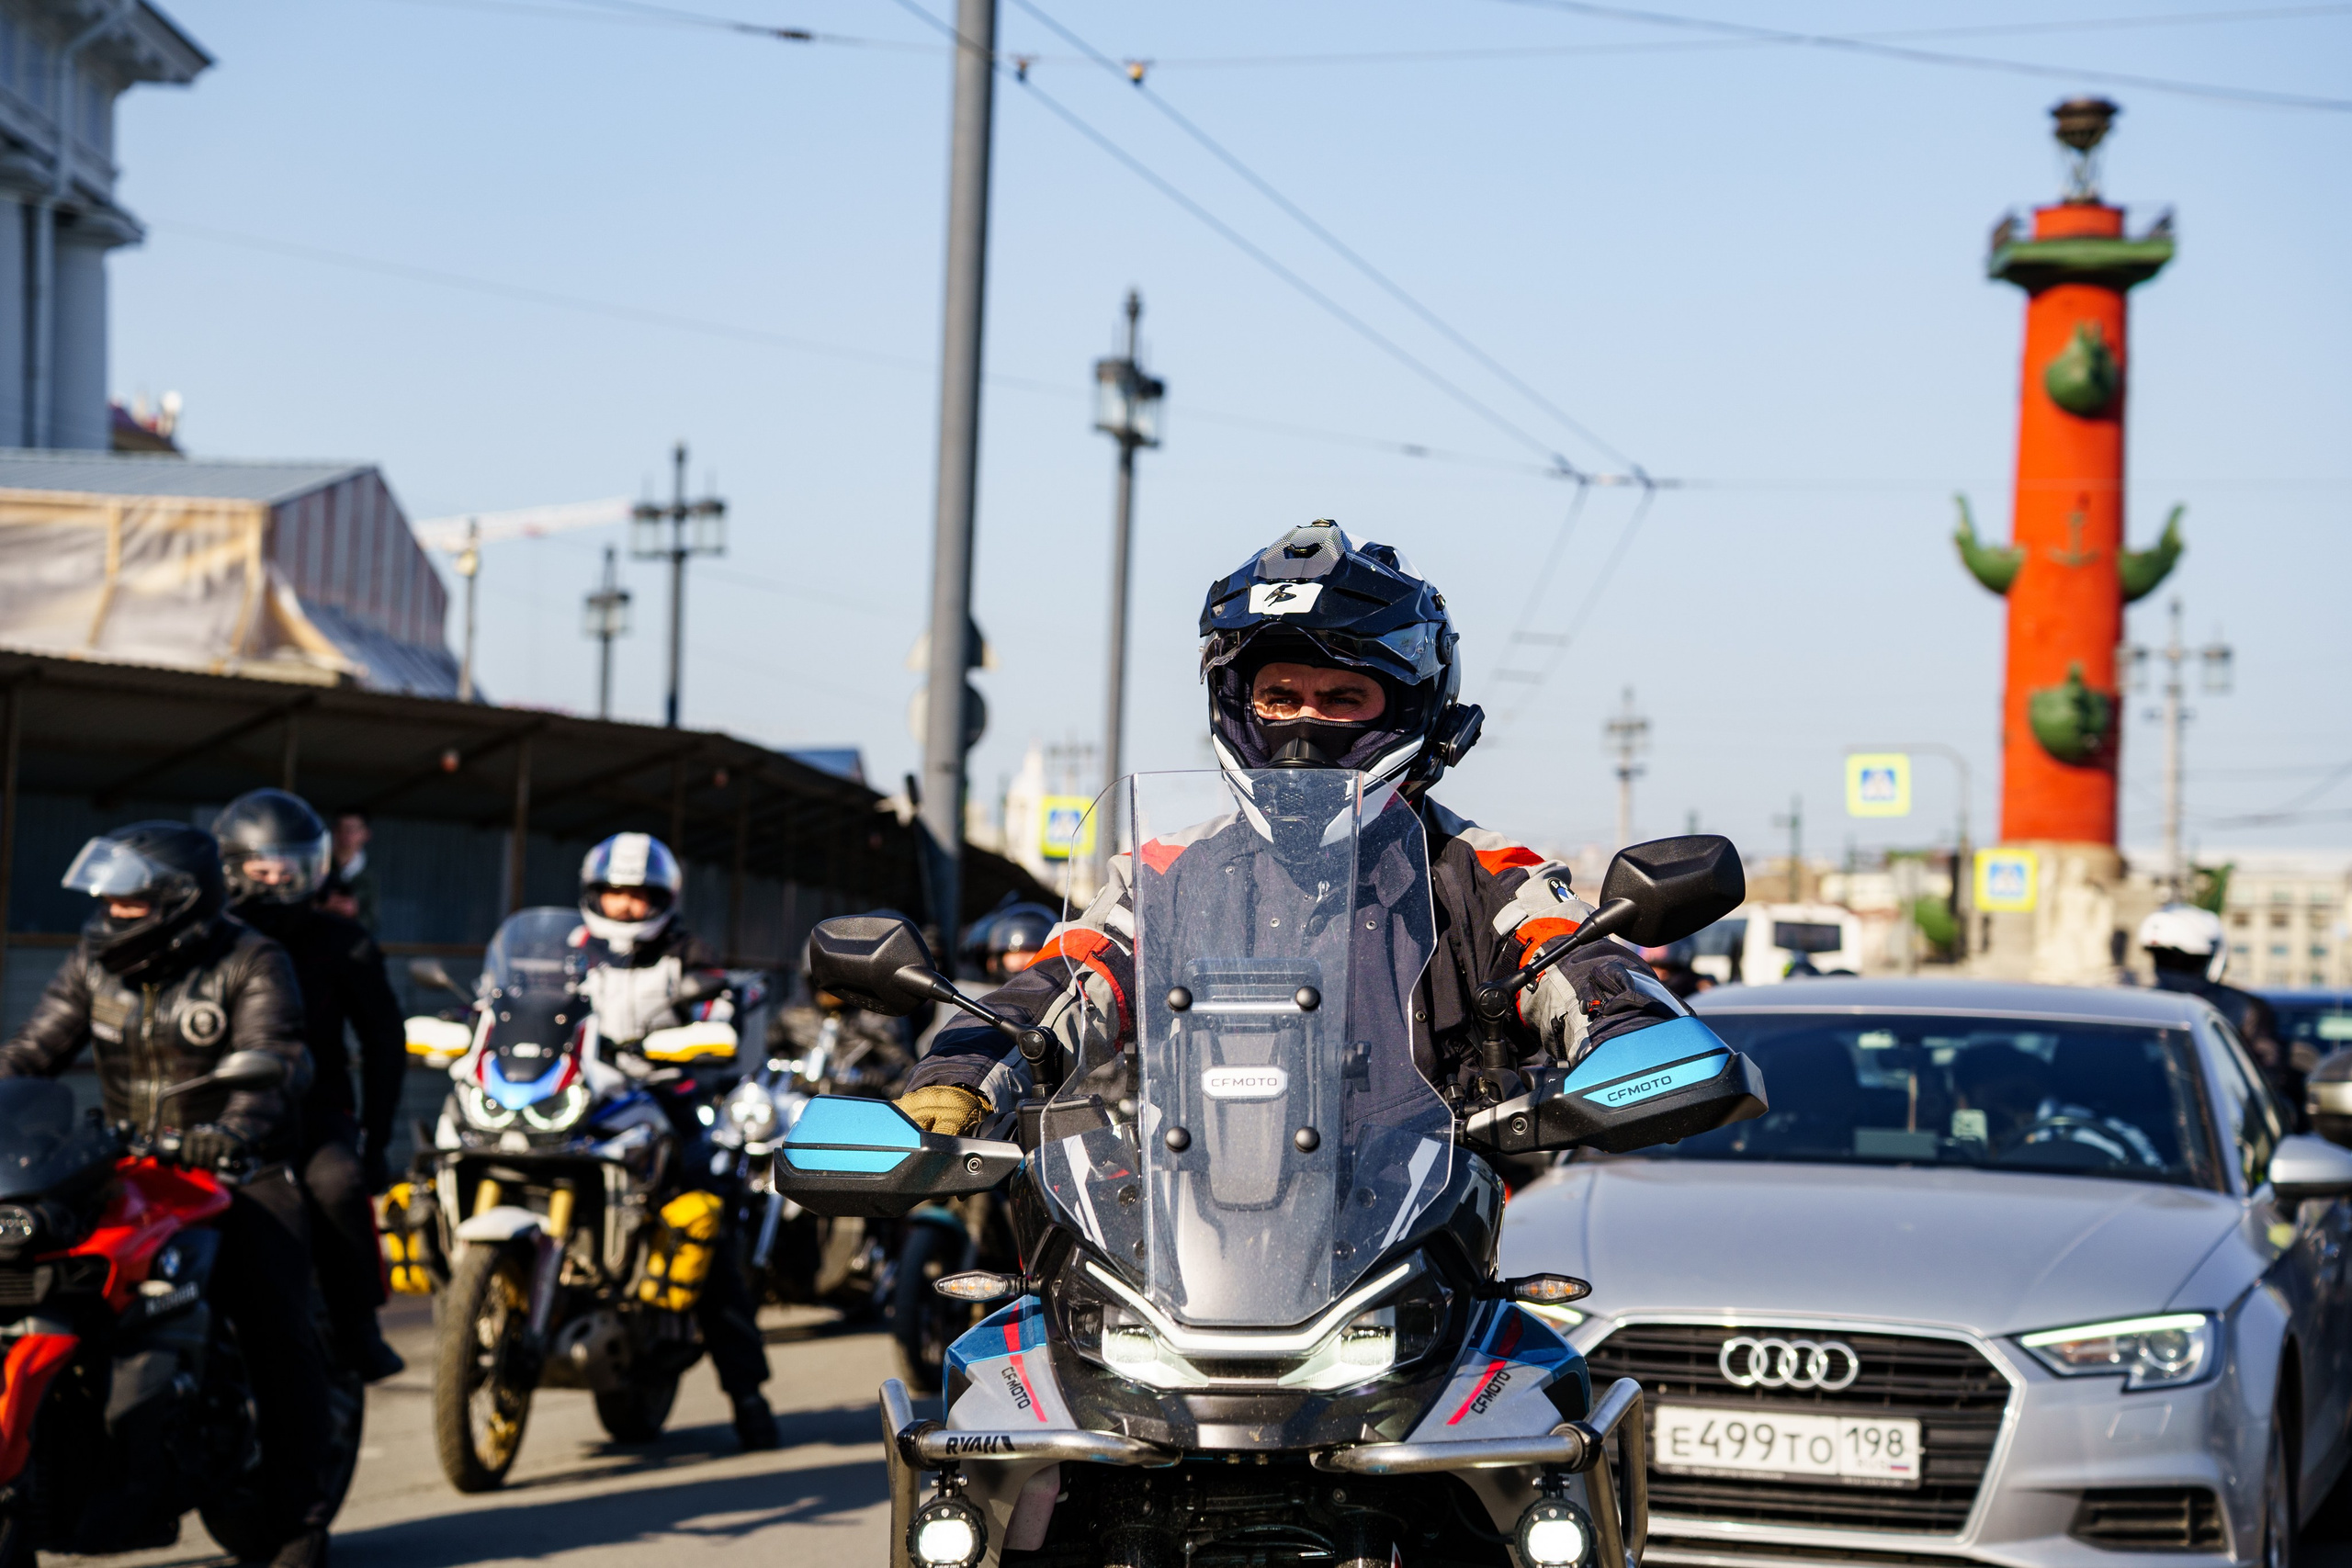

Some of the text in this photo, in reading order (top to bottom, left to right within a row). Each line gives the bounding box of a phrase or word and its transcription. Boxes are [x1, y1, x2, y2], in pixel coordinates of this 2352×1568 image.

[1211, 1077, 1278, 1087] CFMOTO
[1607, 1075, 1672, 1102] CFMOTO
[1001, 1366, 1031, 1410] CFMOTO
[1470, 1371, 1511, 1415] CFMOTO
[1845, 1427, 1905, 1459] 198
